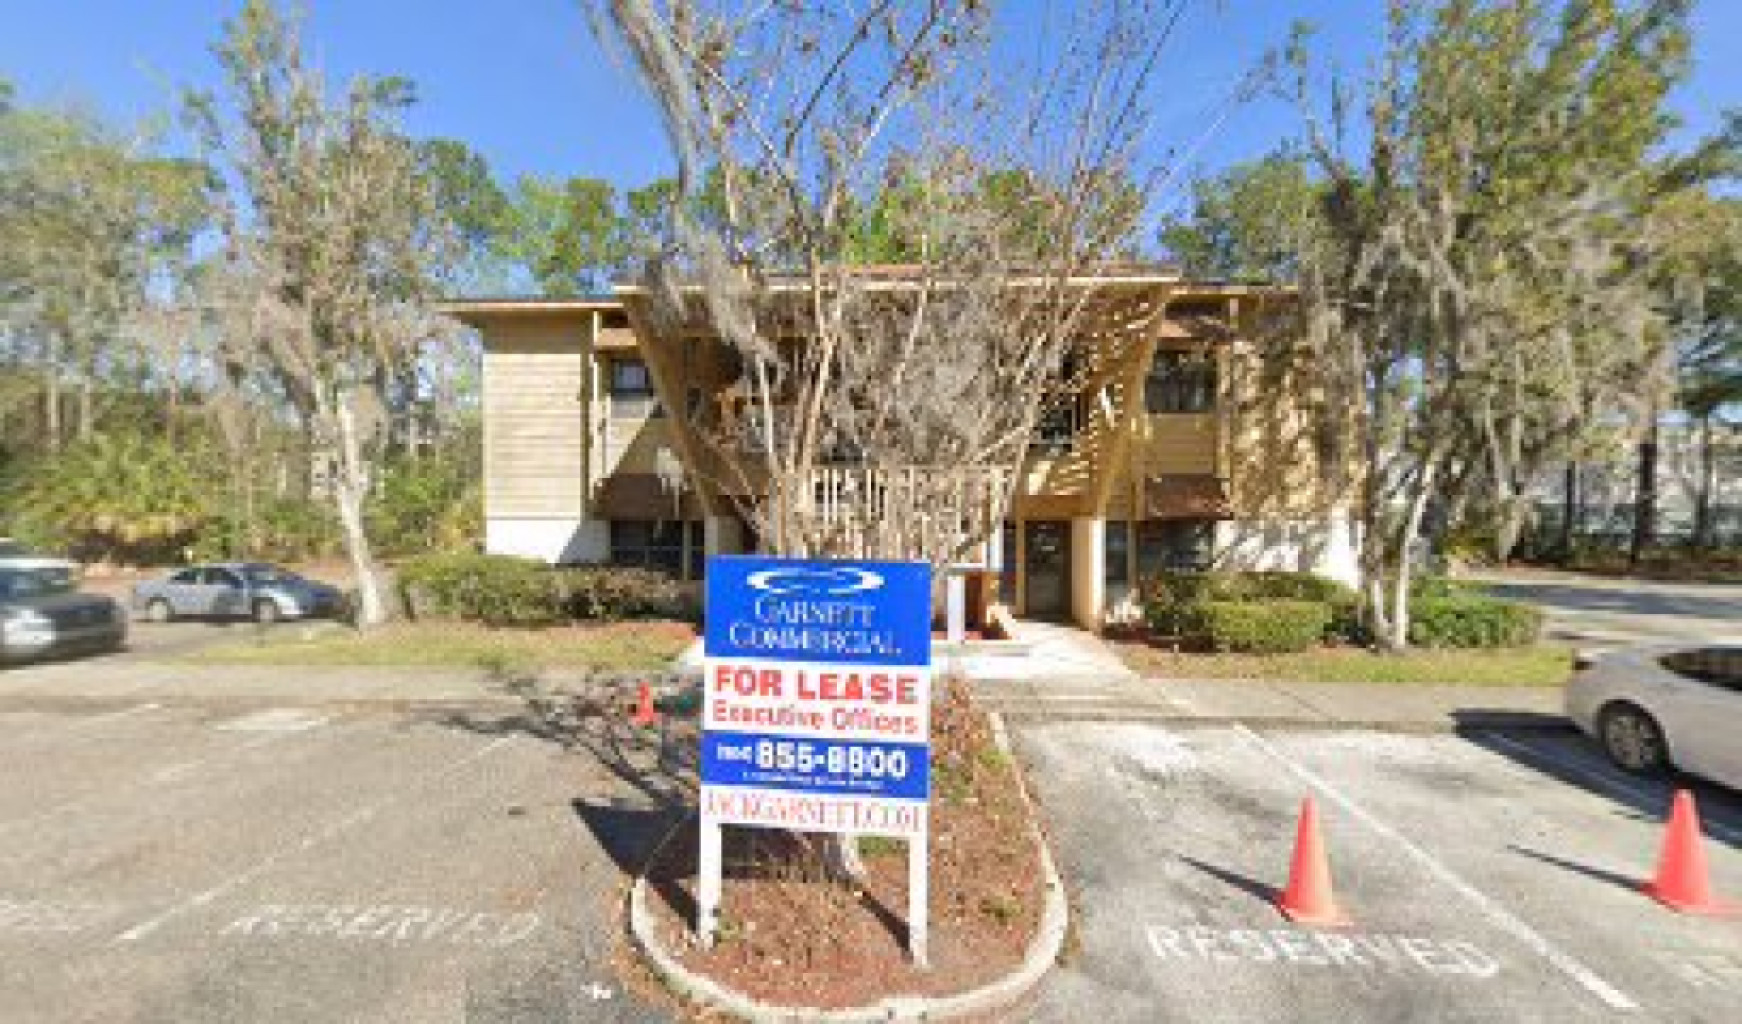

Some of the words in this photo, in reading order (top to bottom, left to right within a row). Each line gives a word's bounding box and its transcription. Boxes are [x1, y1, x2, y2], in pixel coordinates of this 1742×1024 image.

[755, 594, 876, 627] GARNETT
[729, 621, 903, 654] COMMERCIAL
[714, 664, 783, 697] FOR
[796, 672, 919, 705] LEASE
[712, 698, 825, 730] Executive
[831, 707, 919, 735] Offices
[754, 740, 907, 778] 855-8800
[1146, 922, 1502, 978] RESERVED
